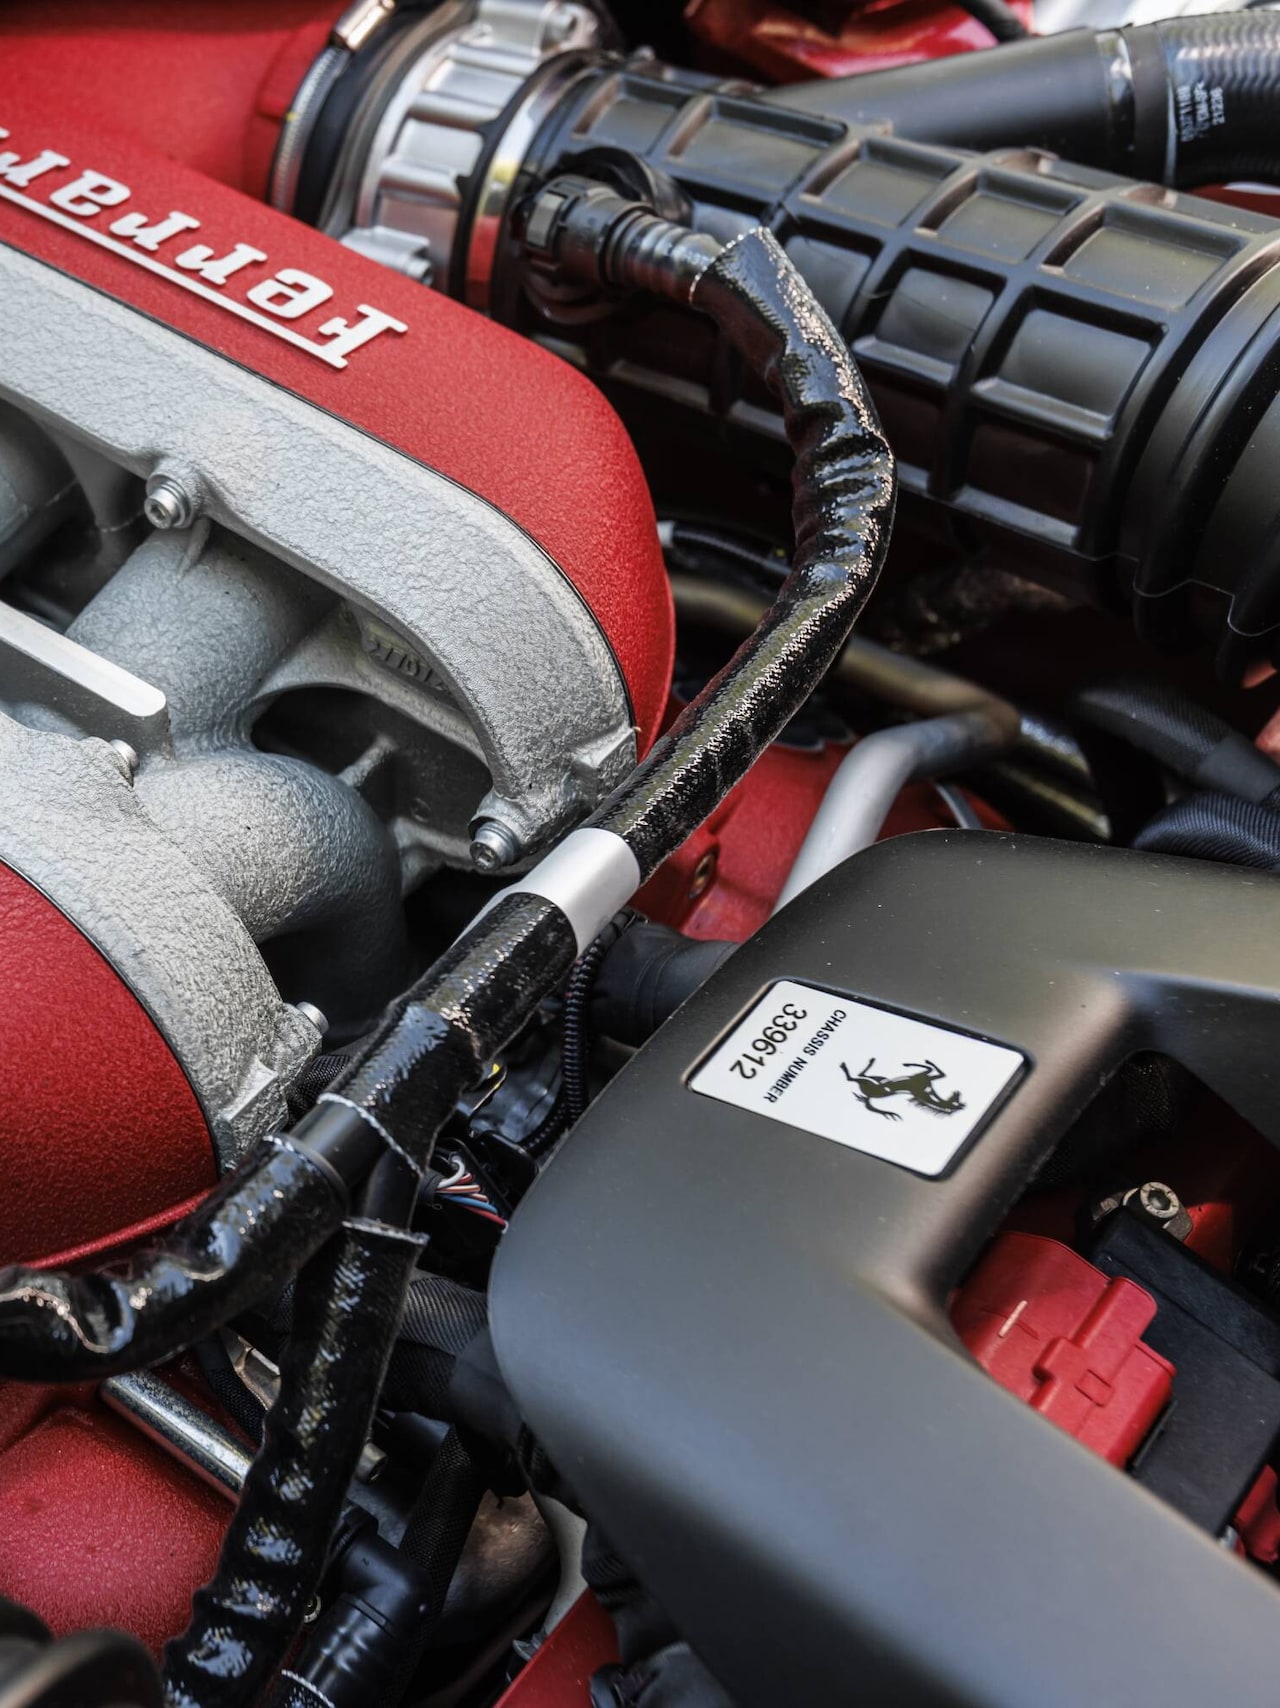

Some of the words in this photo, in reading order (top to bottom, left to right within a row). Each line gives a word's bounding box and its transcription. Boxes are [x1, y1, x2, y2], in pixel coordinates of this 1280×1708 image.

[729, 1003, 807, 1079] 339612
[803, 1008, 847, 1057] CHASSIS
[763, 1055, 808, 1103] NUMBER
